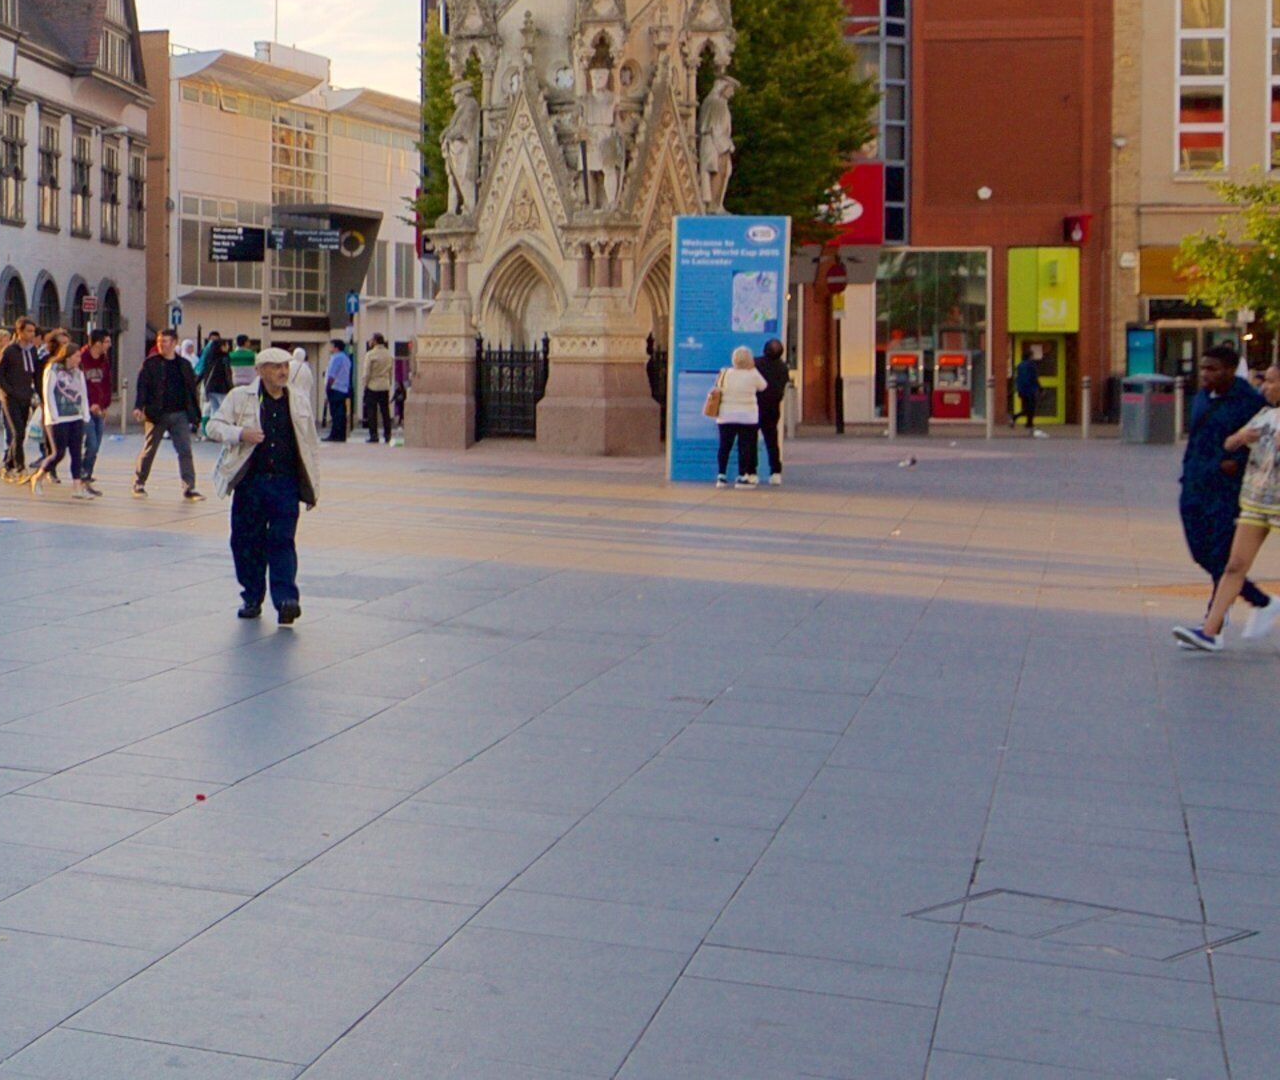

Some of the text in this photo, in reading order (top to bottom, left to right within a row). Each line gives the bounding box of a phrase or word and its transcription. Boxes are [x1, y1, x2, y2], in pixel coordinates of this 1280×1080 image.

[682, 249, 711, 258] Rugby
[712, 248, 739, 256] World
[741, 248, 757, 257] Cup
